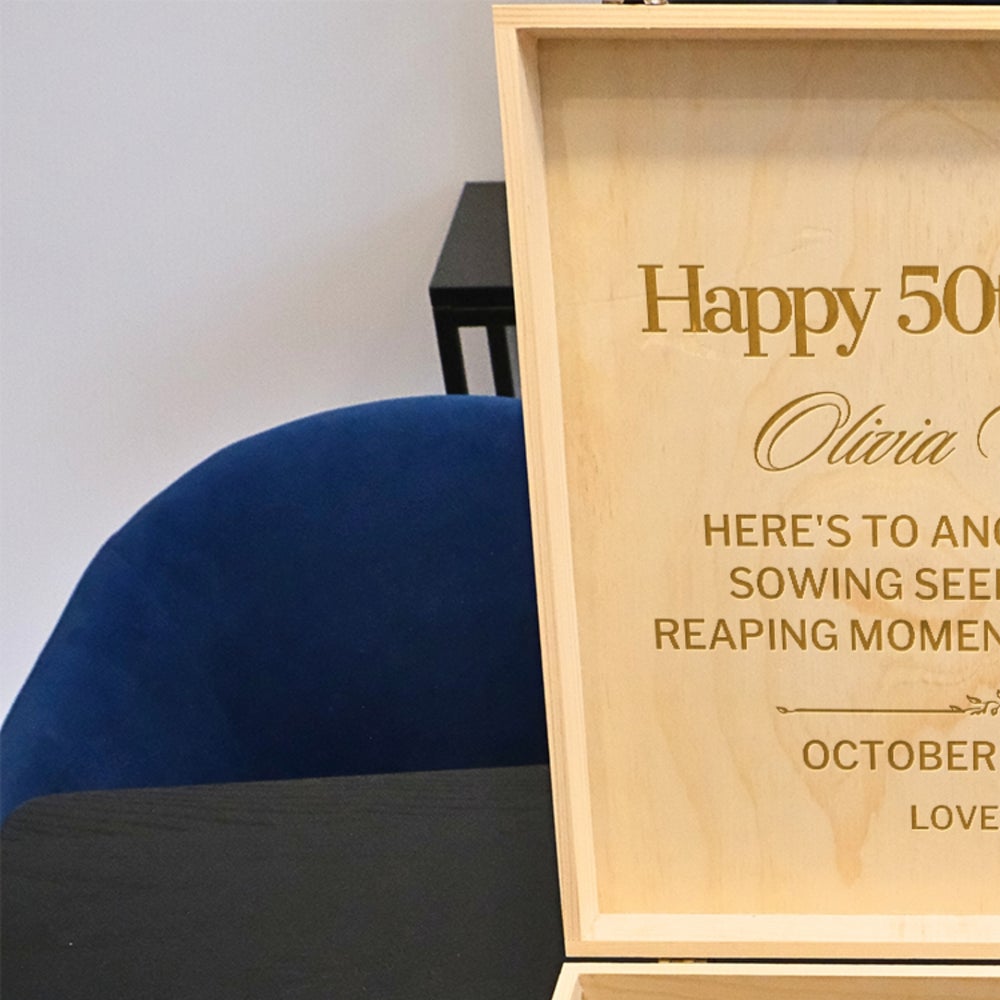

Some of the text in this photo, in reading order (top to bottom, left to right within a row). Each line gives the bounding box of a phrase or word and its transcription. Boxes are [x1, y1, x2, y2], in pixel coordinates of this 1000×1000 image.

[638, 264, 881, 357] Happy
[753, 391, 957, 472] Olivia
[703, 514, 851, 548] HERE'S
[863, 515, 919, 548] TO
[729, 567, 902, 601] SOWING
[654, 619, 838, 652] REAPING
[802, 740, 995, 773] OCTOBER
